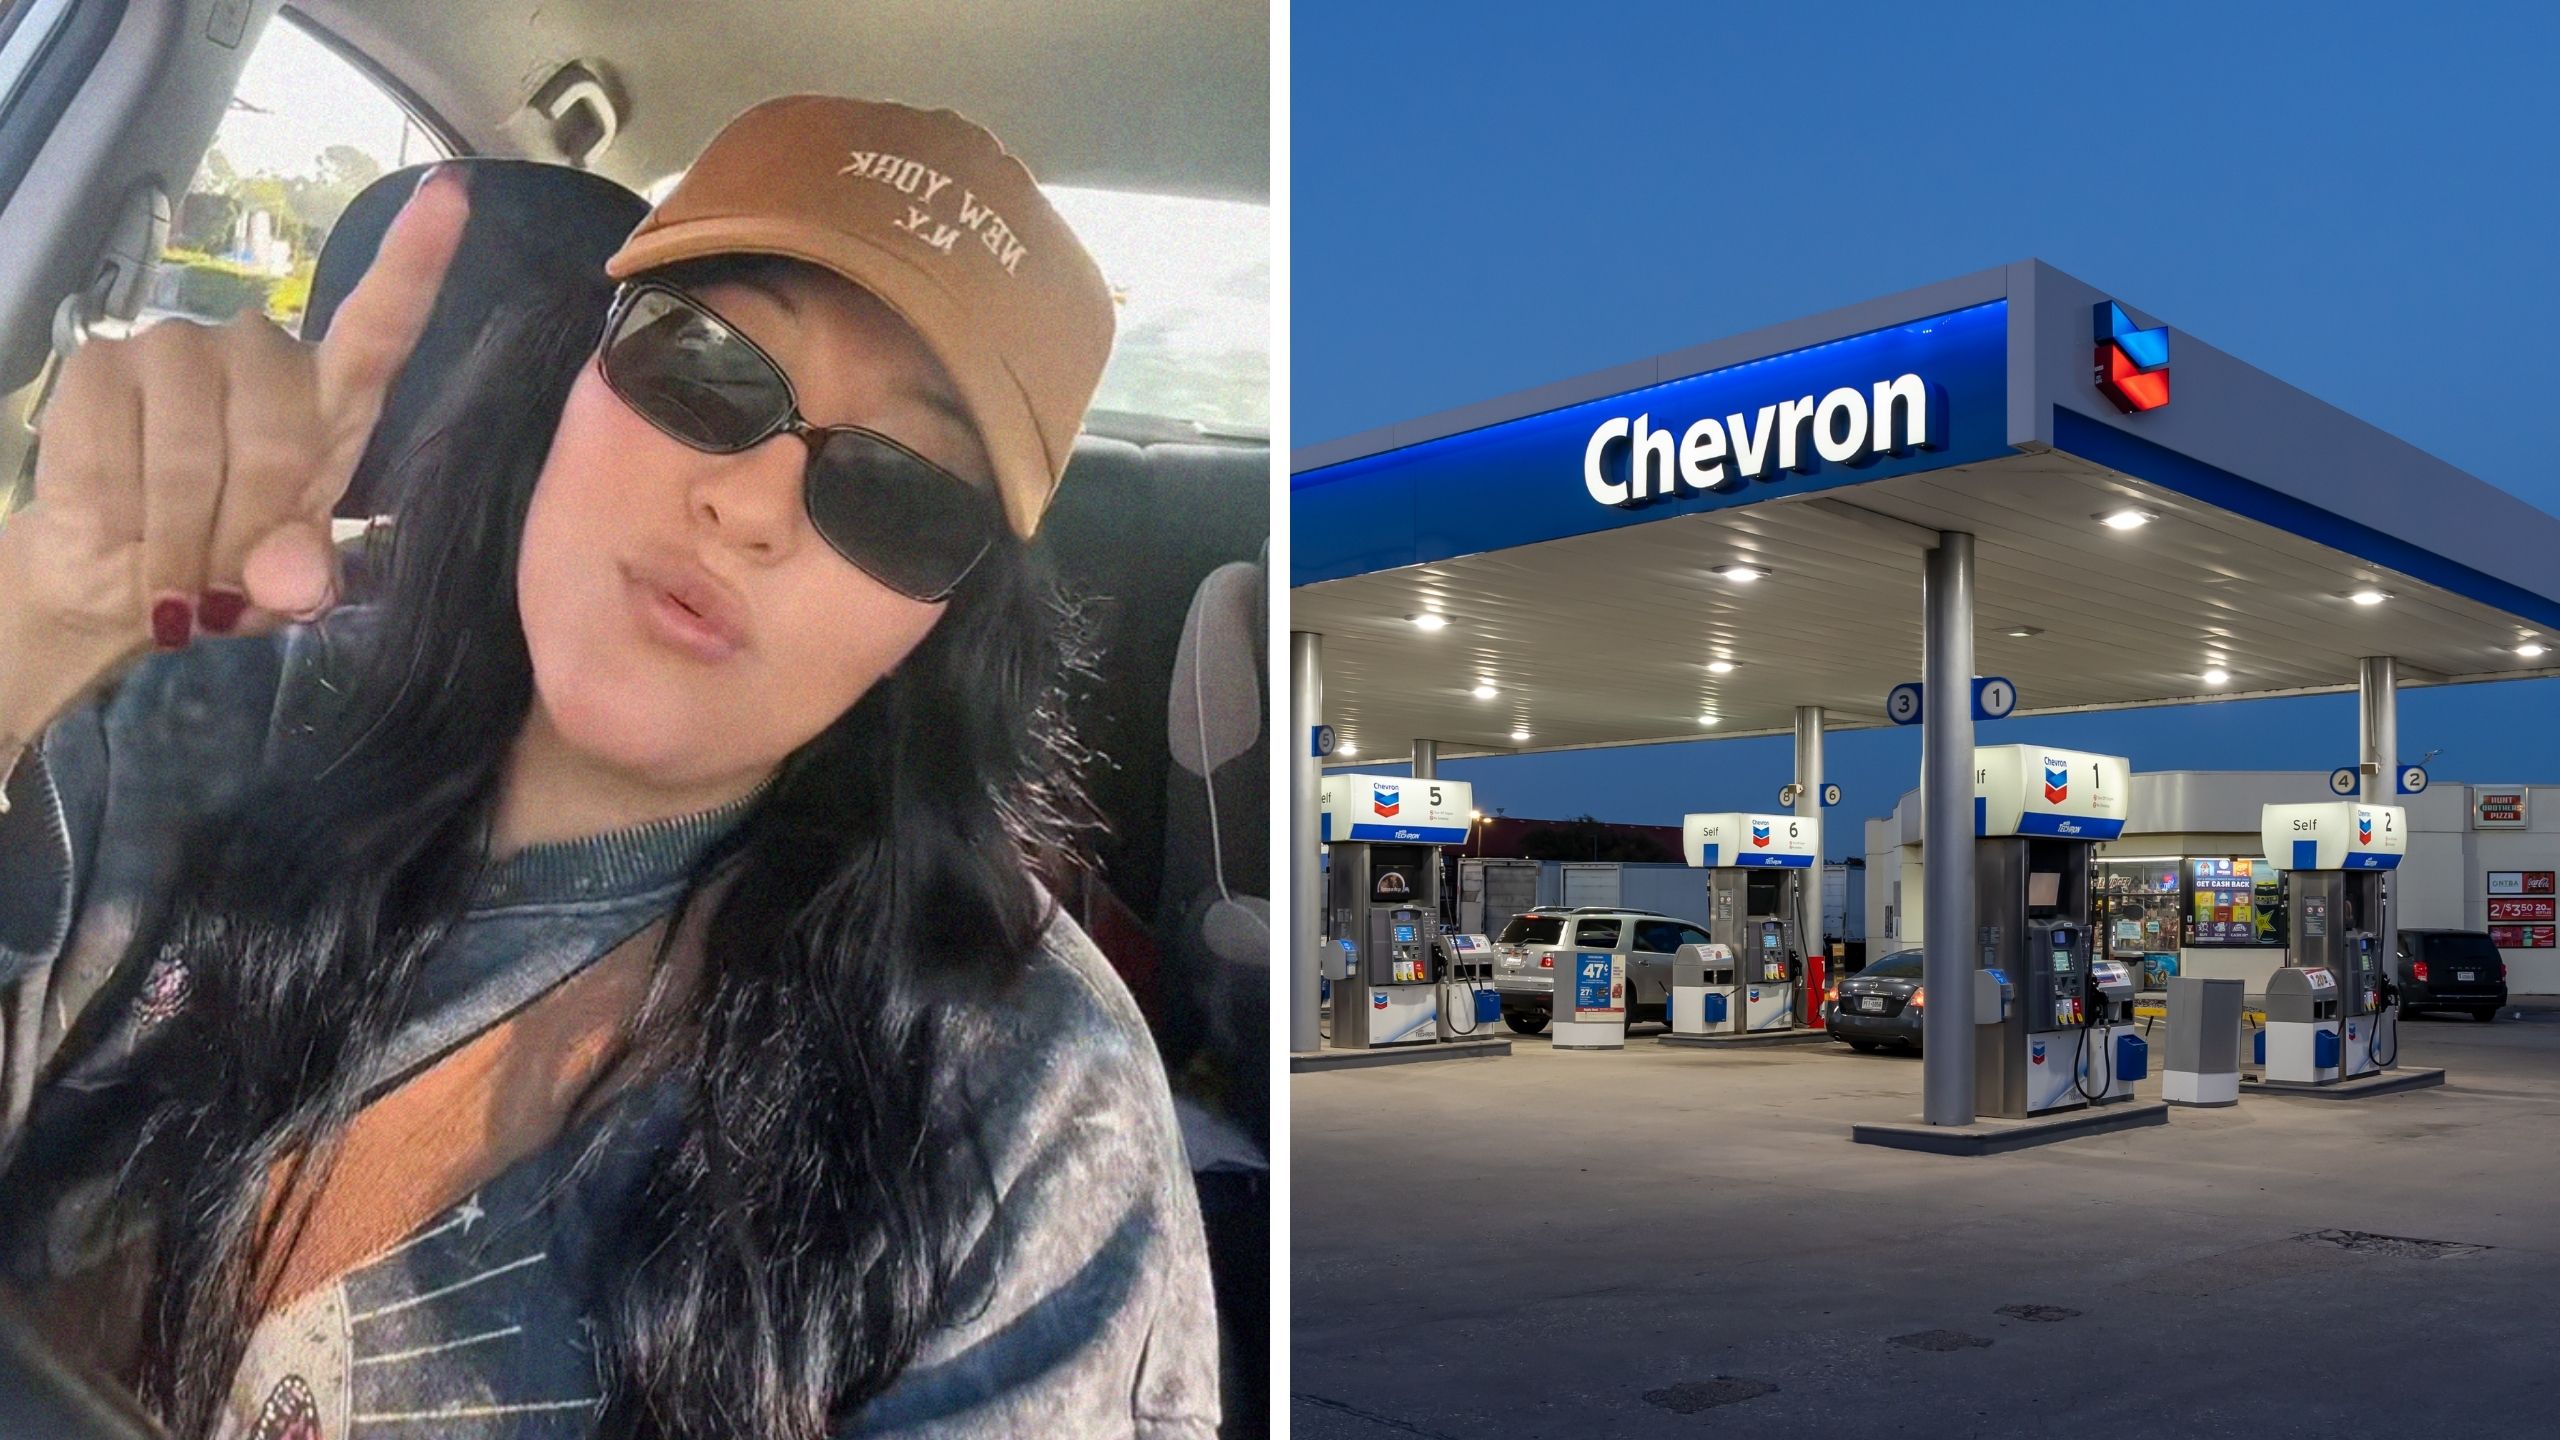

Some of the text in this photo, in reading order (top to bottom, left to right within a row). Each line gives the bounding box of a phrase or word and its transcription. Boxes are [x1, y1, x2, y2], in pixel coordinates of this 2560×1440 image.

[1584, 373, 1927, 506] Chevron
[1898, 695, 1910, 713] 3
[1992, 688, 2000, 707] 1
[1321, 733, 1330, 748] 5
[2043, 756, 2068, 767] Chevron
[2092, 763, 2099, 788] 1
[2338, 775, 2349, 787] 4
[2410, 773, 2420, 786] 2
[1373, 782, 1400, 791] Chevron
[1429, 786, 1442, 807] 5
[1829, 790, 1836, 800] 6
[2292, 819, 2318, 831] Self
[2385, 812, 2392, 832] 2
[1703, 827, 1719, 837] Self
[1789, 822, 1799, 838] 6
[2196, 880, 2209, 888] GET
[2211, 880, 2230, 888] CASH
